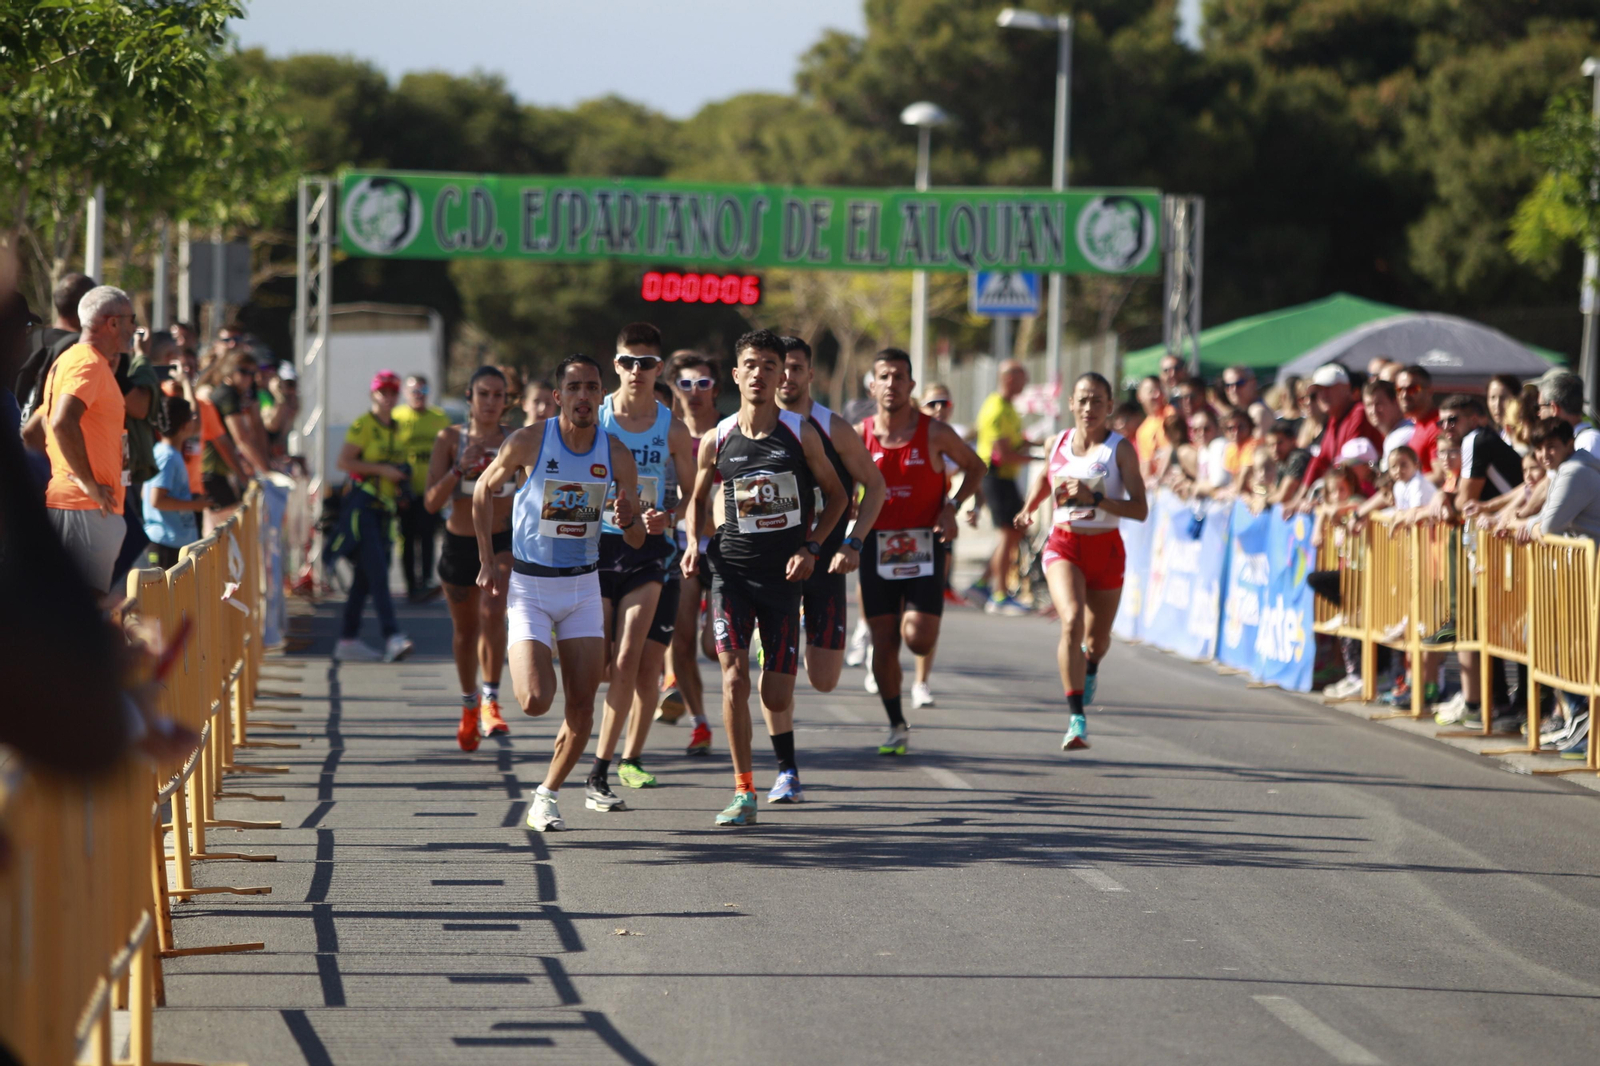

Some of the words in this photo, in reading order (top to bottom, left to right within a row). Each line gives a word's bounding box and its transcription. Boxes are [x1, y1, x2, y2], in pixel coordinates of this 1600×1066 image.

[432, 185, 508, 253] C.D.
[519, 188, 770, 261] ESPARTANOS
[781, 197, 833, 264] DE
[844, 198, 889, 265] EL
[896, 199, 1067, 271] ALQUIAN
[550, 489, 590, 510] 204
[749, 484, 775, 504] 19
